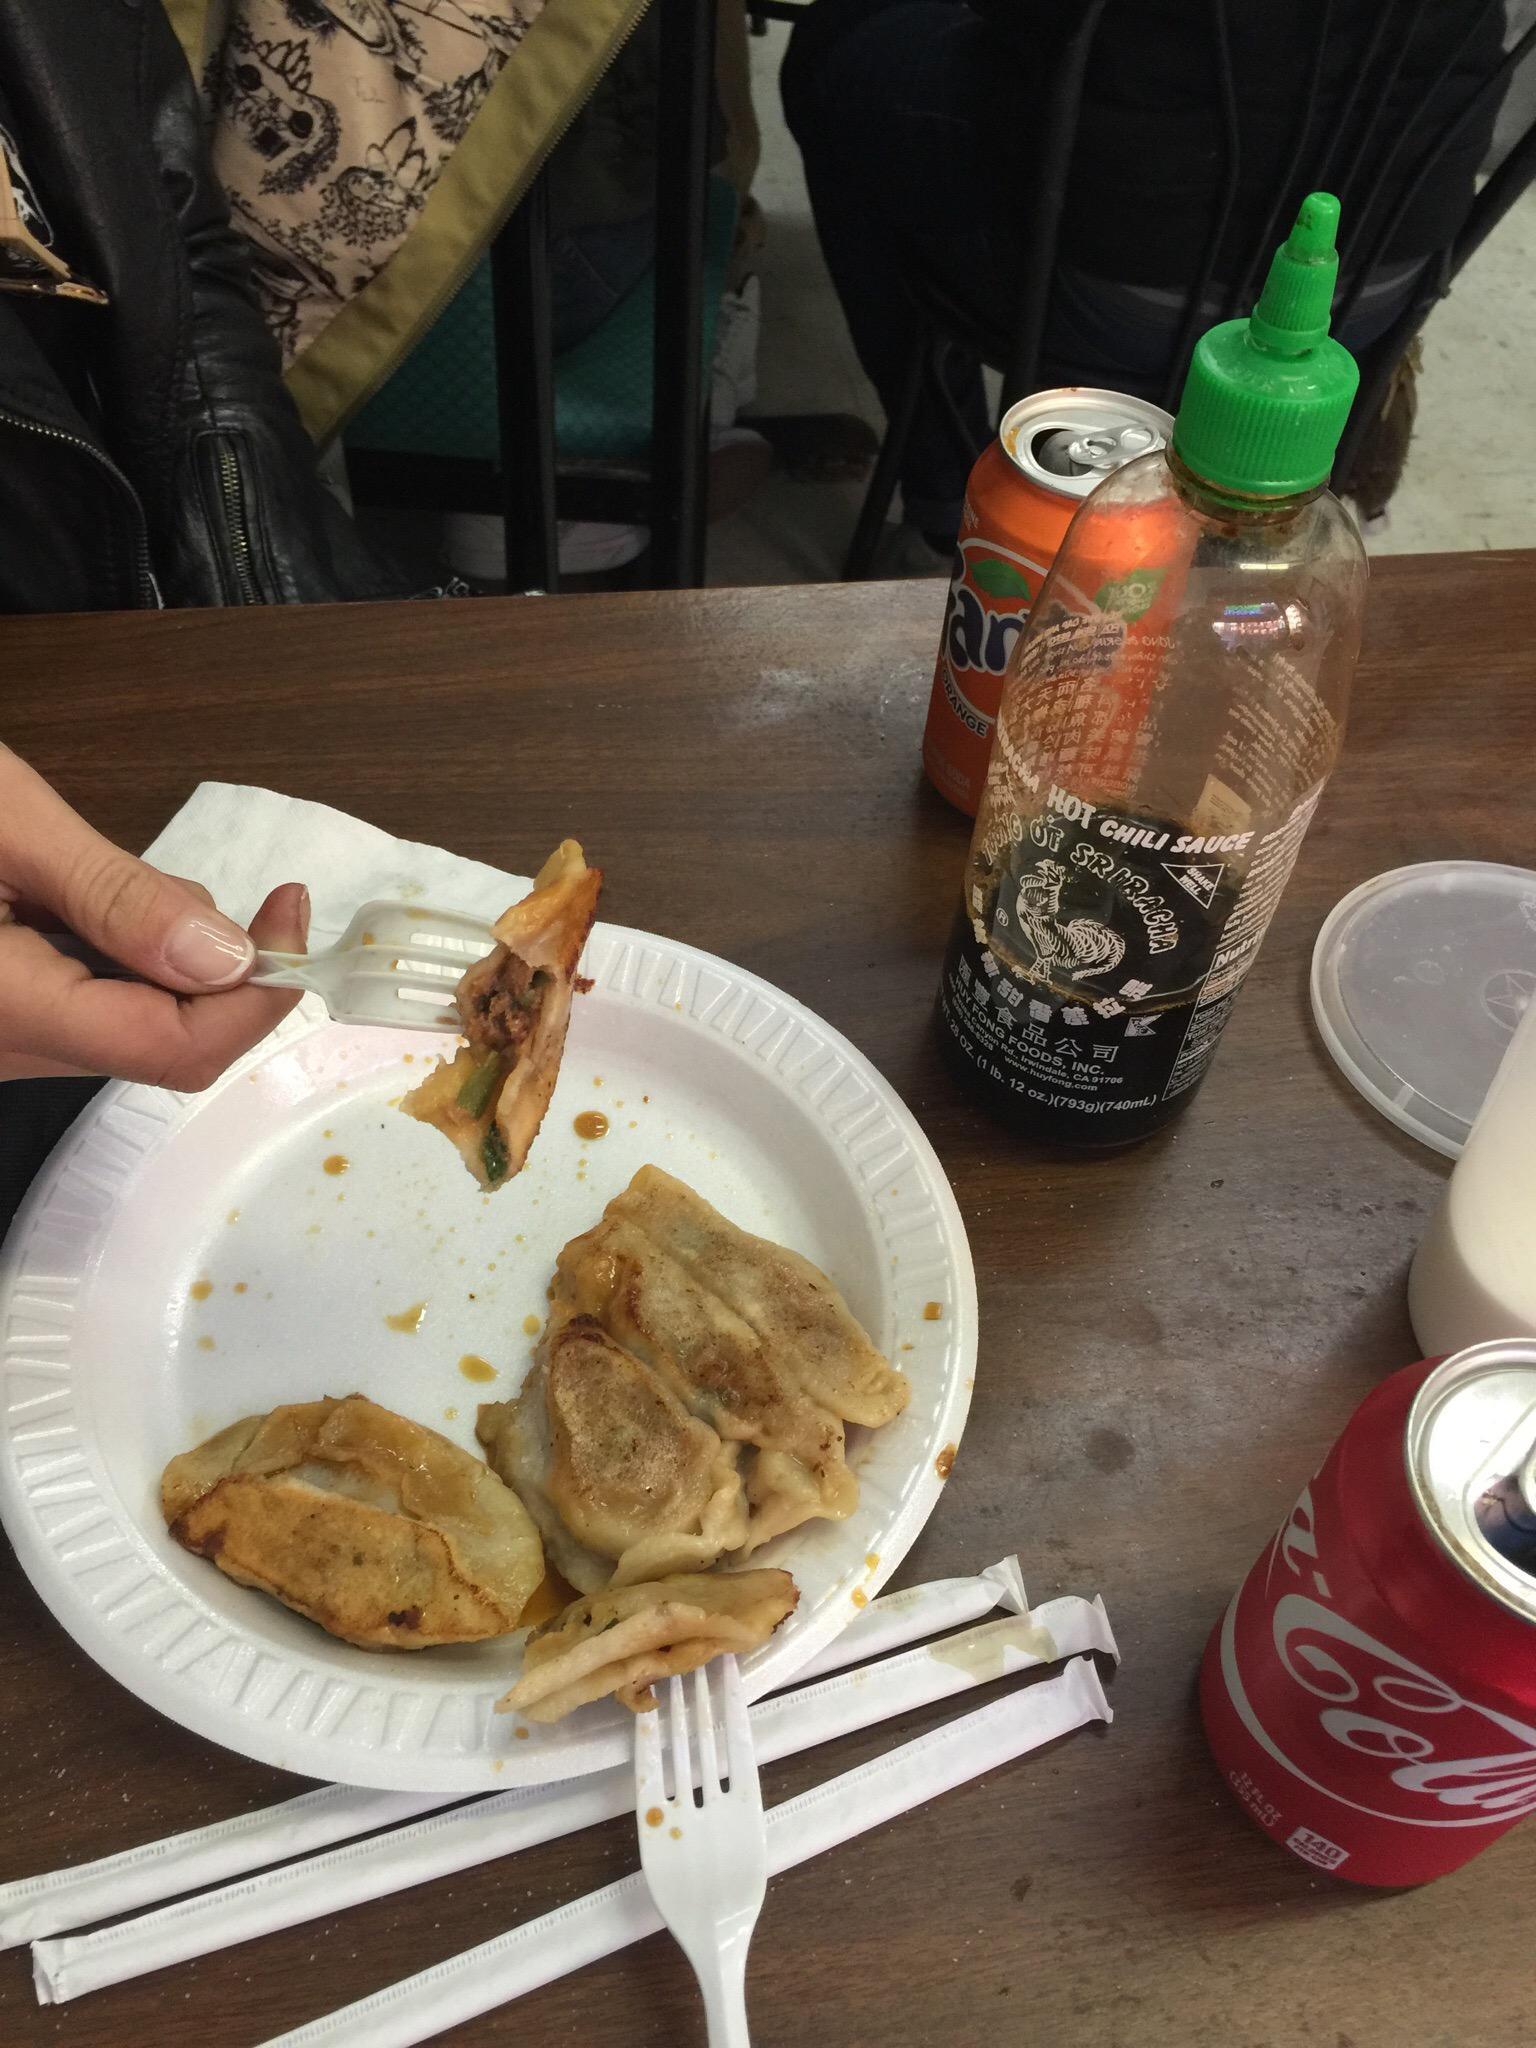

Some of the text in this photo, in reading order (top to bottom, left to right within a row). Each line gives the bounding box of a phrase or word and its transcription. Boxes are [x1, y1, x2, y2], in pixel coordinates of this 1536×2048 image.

[1047, 784, 1096, 829] HOT
[1100, 819, 1170, 851] CHILI
[1170, 831, 1256, 854] SAUCE
[1178, 874, 1203, 896] WELL
[1186, 866, 1216, 891] SHAKE
[1070, 843, 1179, 954] SRIRACHA
[955, 975, 972, 1004] HUY
[972, 1003, 1005, 1039] FONG
[1008, 1035, 1066, 1069] FOODS,
[1071, 1061, 1105, 1075] INC.
[960, 1035, 975, 1059] OZ.
[989, 1064, 1005, 1083] lb.
[1009, 1078, 1025, 1093] 12
[1004, 1055, 1098, 1092] www.huyfong.com
[1073, 1073, 1090, 1083] CA
[1091, 1076, 1124, 1085] 91706
[1304, 1832, 1342, 1858] 140
